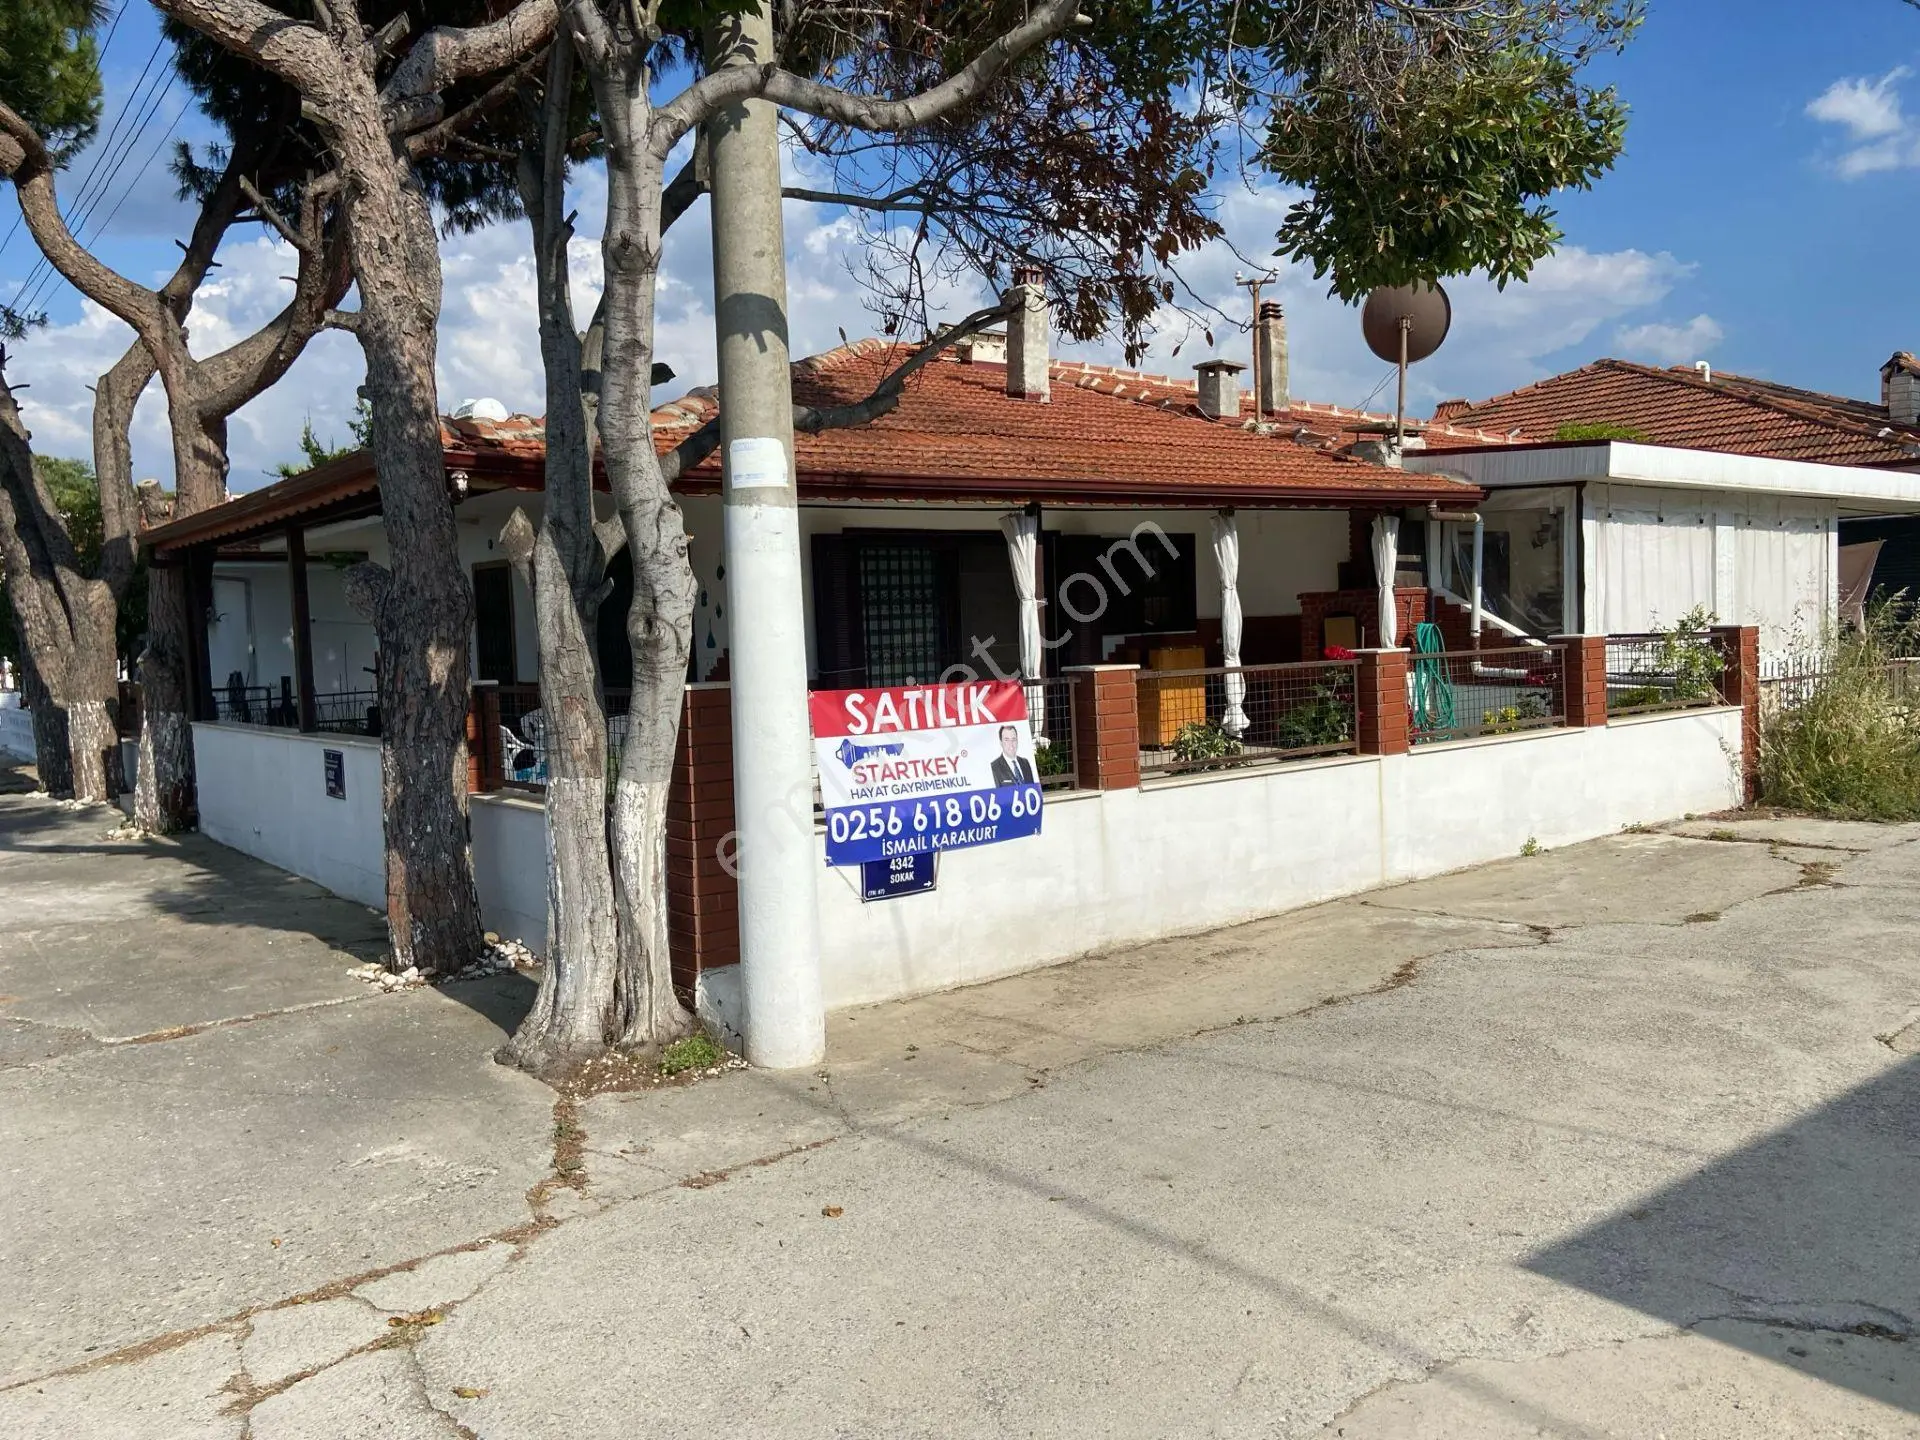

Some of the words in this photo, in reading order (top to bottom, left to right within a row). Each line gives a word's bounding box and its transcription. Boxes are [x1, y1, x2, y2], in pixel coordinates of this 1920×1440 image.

[844, 684, 997, 735] SATILIK
[853, 756, 960, 785] STARTKEY
[850, 785, 889, 800] HAYAT
[891, 776, 971, 795] GAYRİMENKUL
[830, 806, 903, 843] 0256
[913, 798, 963, 832] 618
[969, 793, 1001, 824] 06
[1010, 787, 1041, 818] 60
[882, 834, 927, 856] İSMAİL
[931, 825, 999, 849] KARAKURT
[889, 855, 914, 871] 4342
[890, 871, 915, 884] SOKAK
